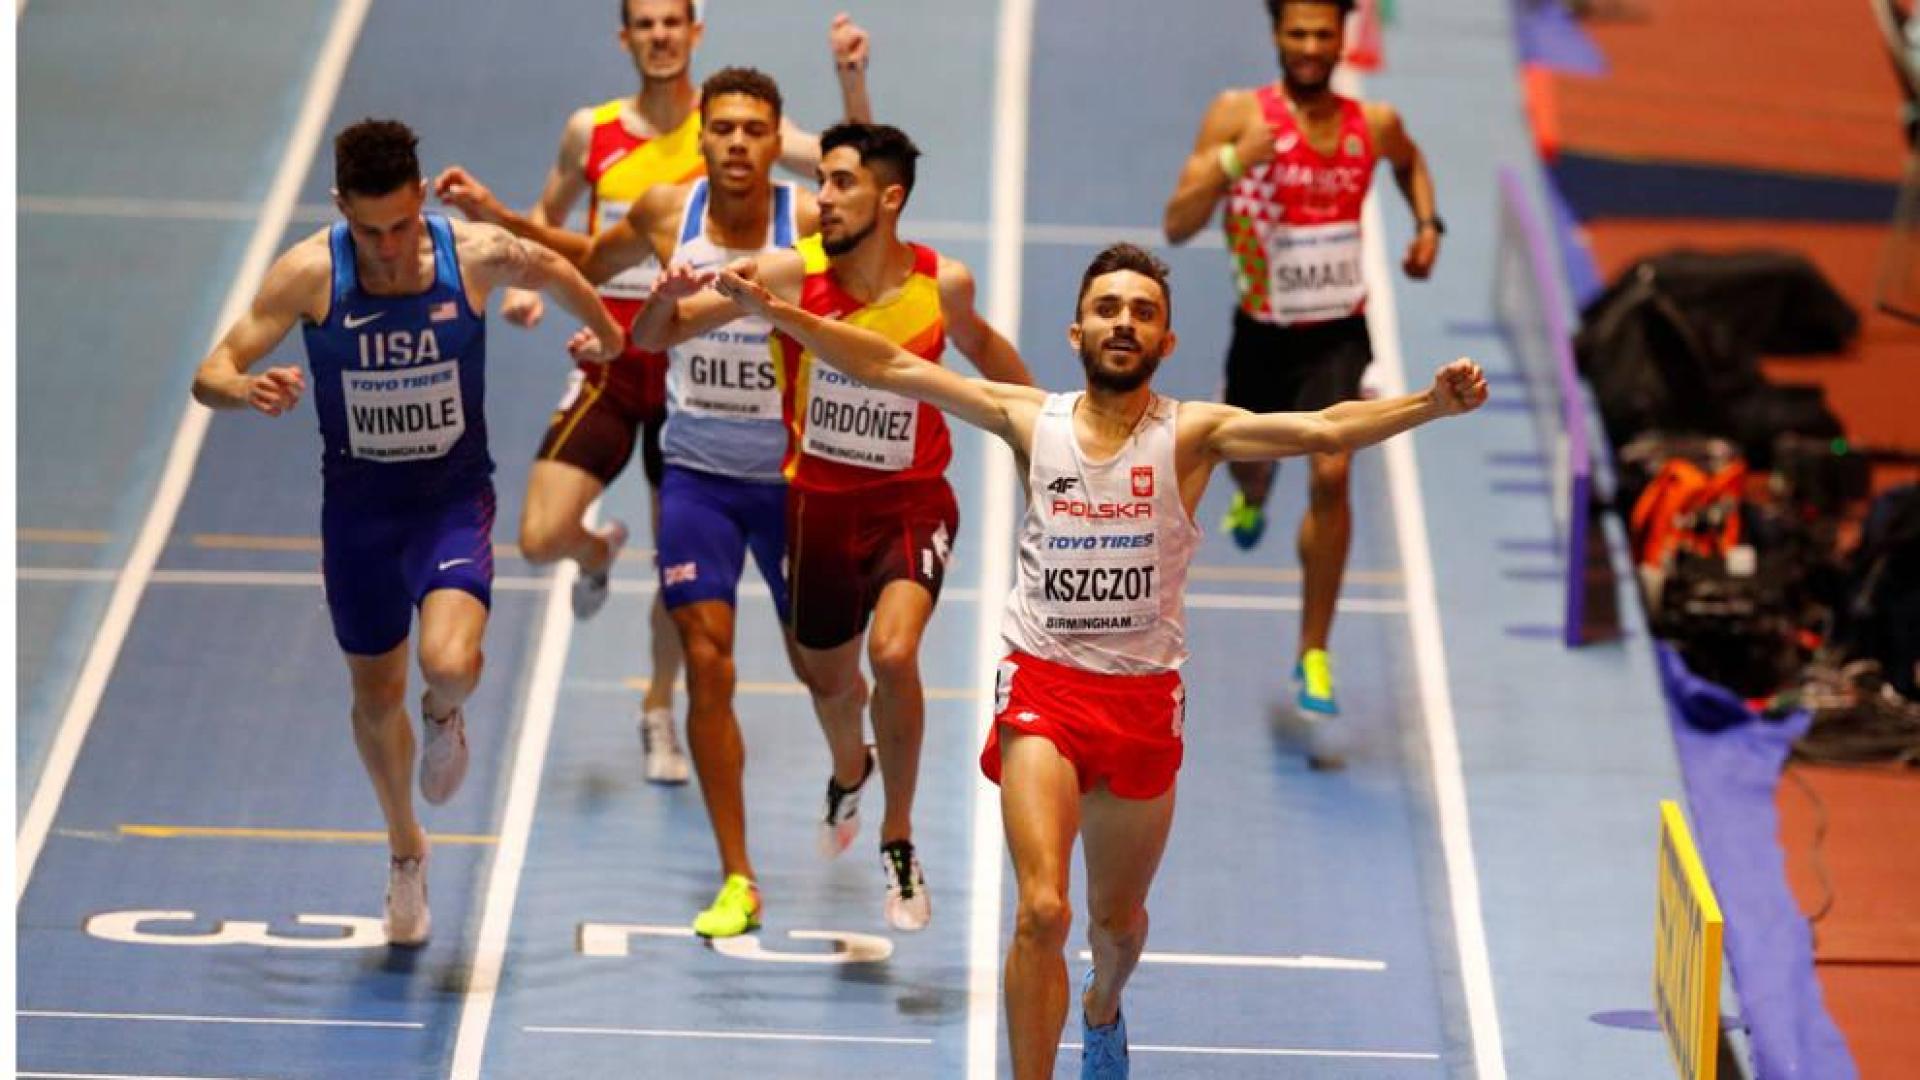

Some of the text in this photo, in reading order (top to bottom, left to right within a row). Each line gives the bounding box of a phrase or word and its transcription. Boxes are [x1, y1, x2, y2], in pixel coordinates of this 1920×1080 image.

[359, 329, 440, 369] USA
[351, 378, 399, 391] TOYO
[690, 356, 776, 390] GILES
[352, 398, 458, 434] WINDLE
[810, 396, 913, 441] ORDÓÑEZ
[1052, 501, 1153, 519] POLSKA
[1048, 533, 1154, 550] TOYO TIRES
[1044, 566, 1154, 602] KSZCZOT
[1046, 616, 1132, 629] BIRMINGHAM
